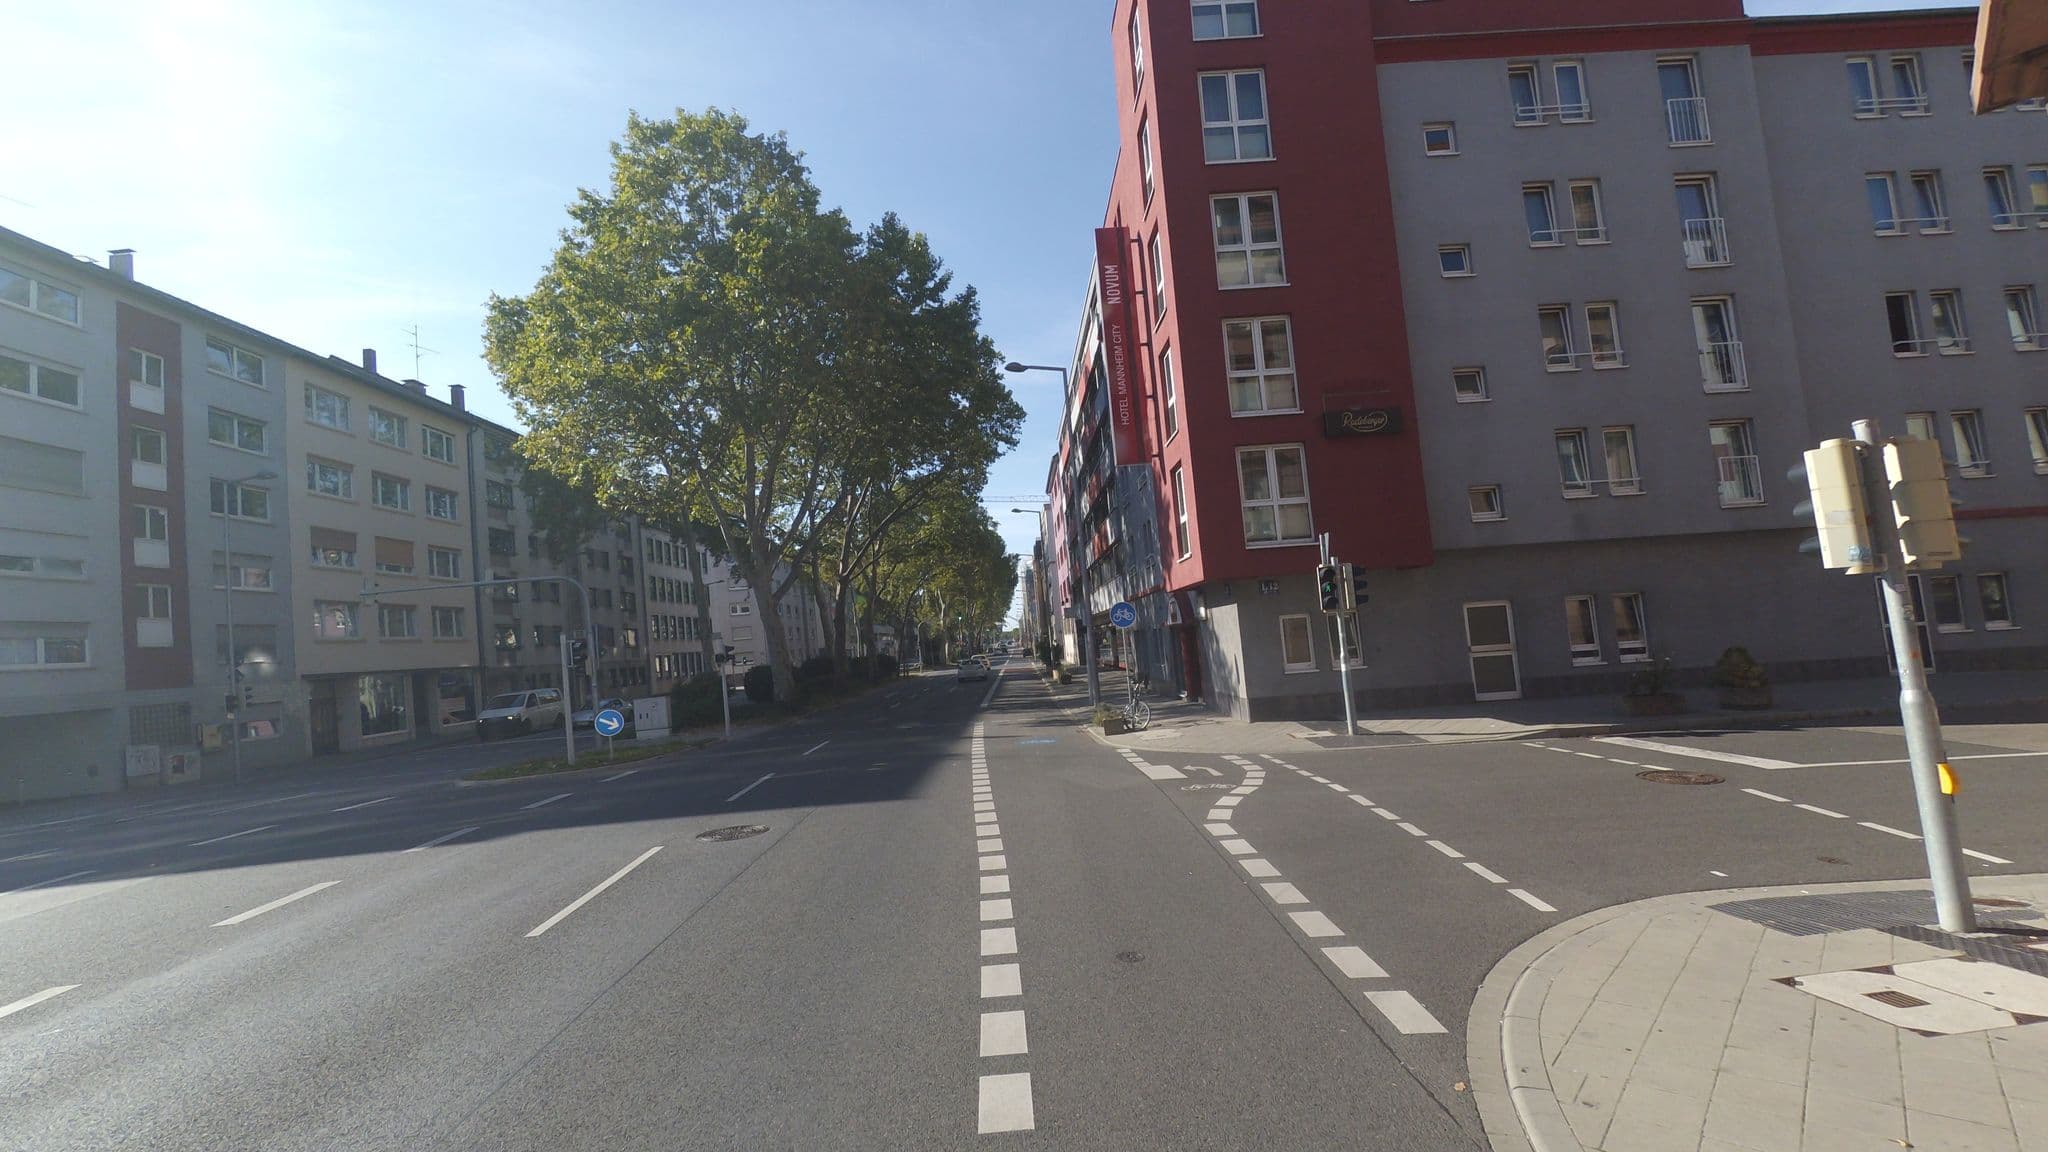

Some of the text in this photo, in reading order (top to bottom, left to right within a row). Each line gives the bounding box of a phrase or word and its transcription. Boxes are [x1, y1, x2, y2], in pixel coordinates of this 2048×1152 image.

[1104, 264, 1121, 305] NOVUM
[1111, 323, 1130, 426] HOTEL MANNHEIM CITY
